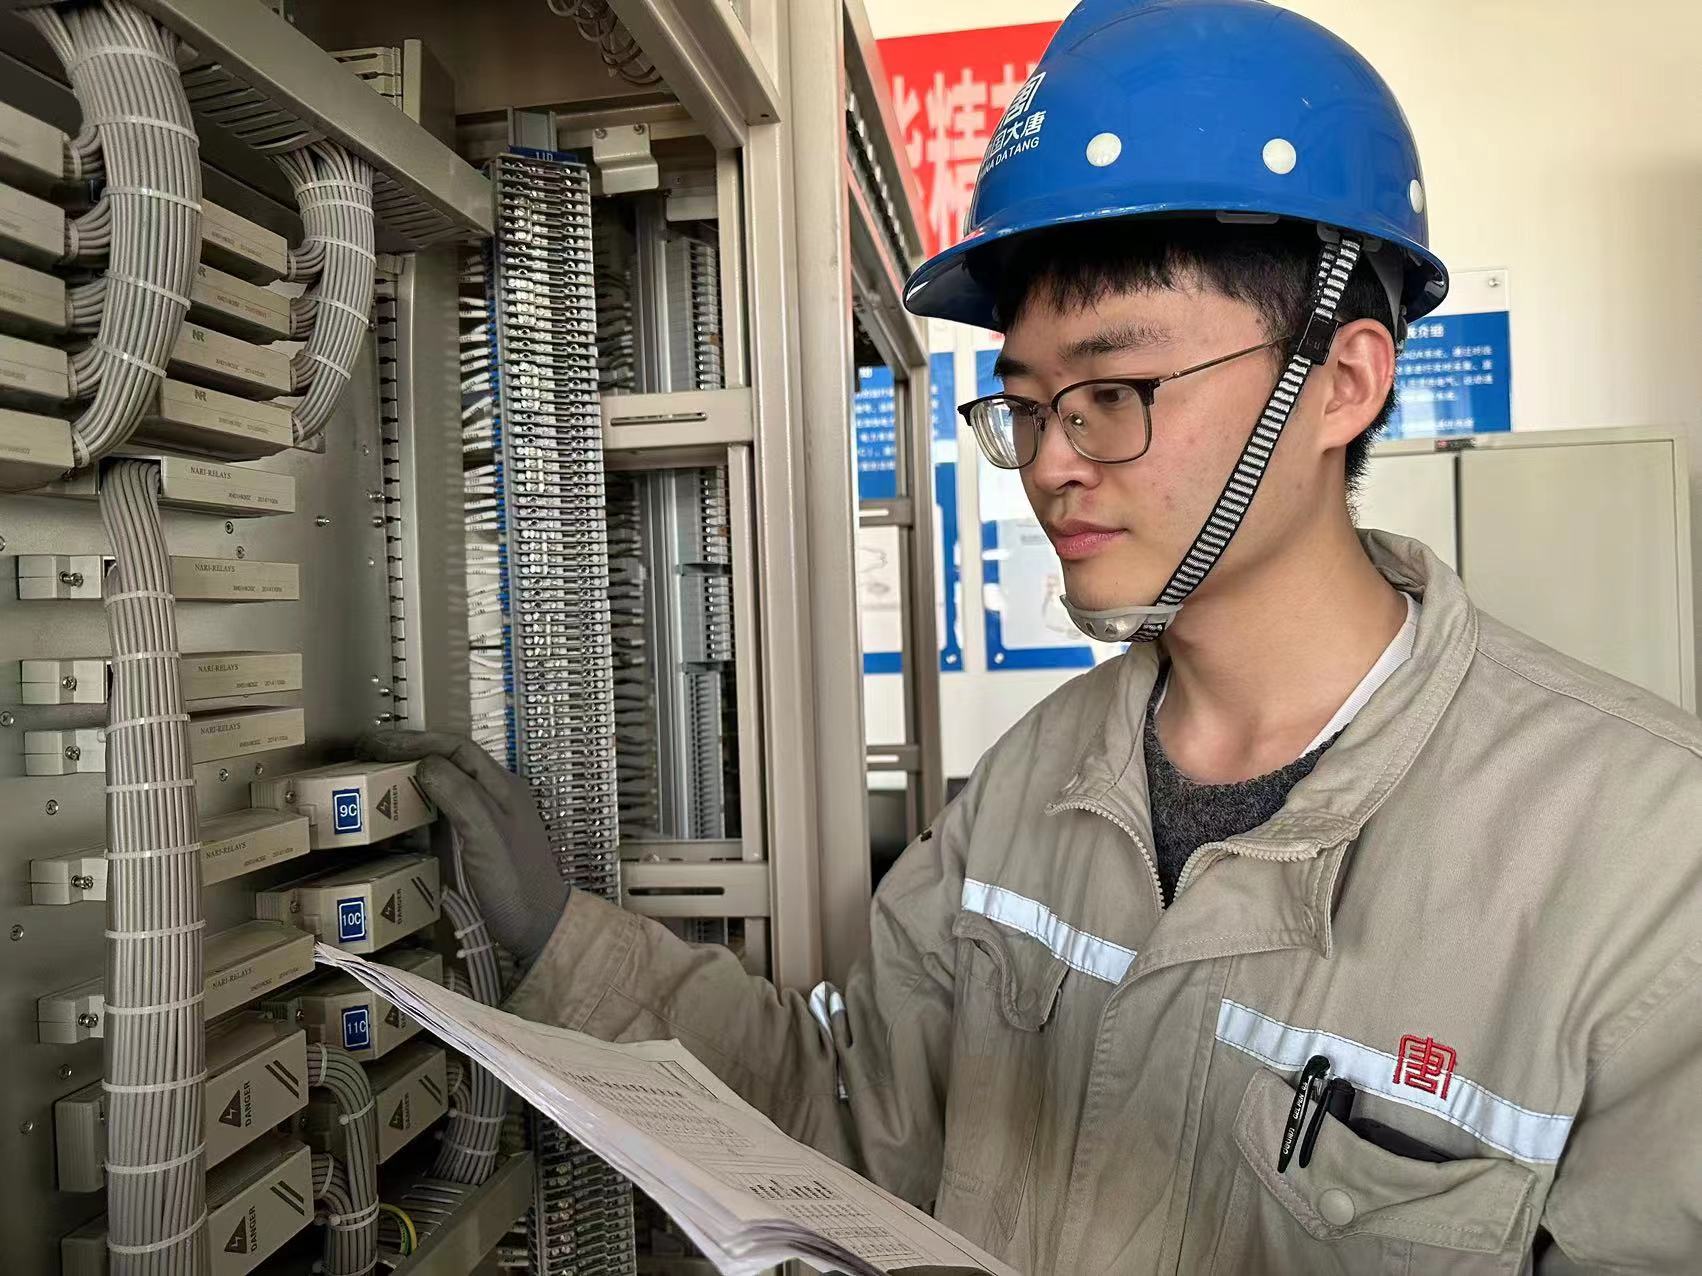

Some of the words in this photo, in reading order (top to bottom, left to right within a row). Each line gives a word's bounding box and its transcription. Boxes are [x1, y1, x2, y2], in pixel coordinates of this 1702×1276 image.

[984, 110, 1047, 162] 国大唐
[995, 136, 1040, 166] DATANG
[190, 466, 232, 480] NARI-RELAYS
[194, 563, 236, 573] NARI-RELAYS
[198, 663, 239, 673] NARI-RELAYS
[200, 722, 241, 735] NARI-RELAYS
[340, 803, 357, 818] 9C
[206, 841, 247, 859] NARI-RELAYS
[342, 912, 361, 926] 10C
[212, 967, 252, 990] NARI-RELAYS
[347, 1020, 366, 1035] 11C
[243, 1080, 252, 1127] DANGER
[1296, 1094, 1304, 1107] PEN
[1293, 1106, 1301, 1120] GEL
[248, 1205, 258, 1252] DANGER
